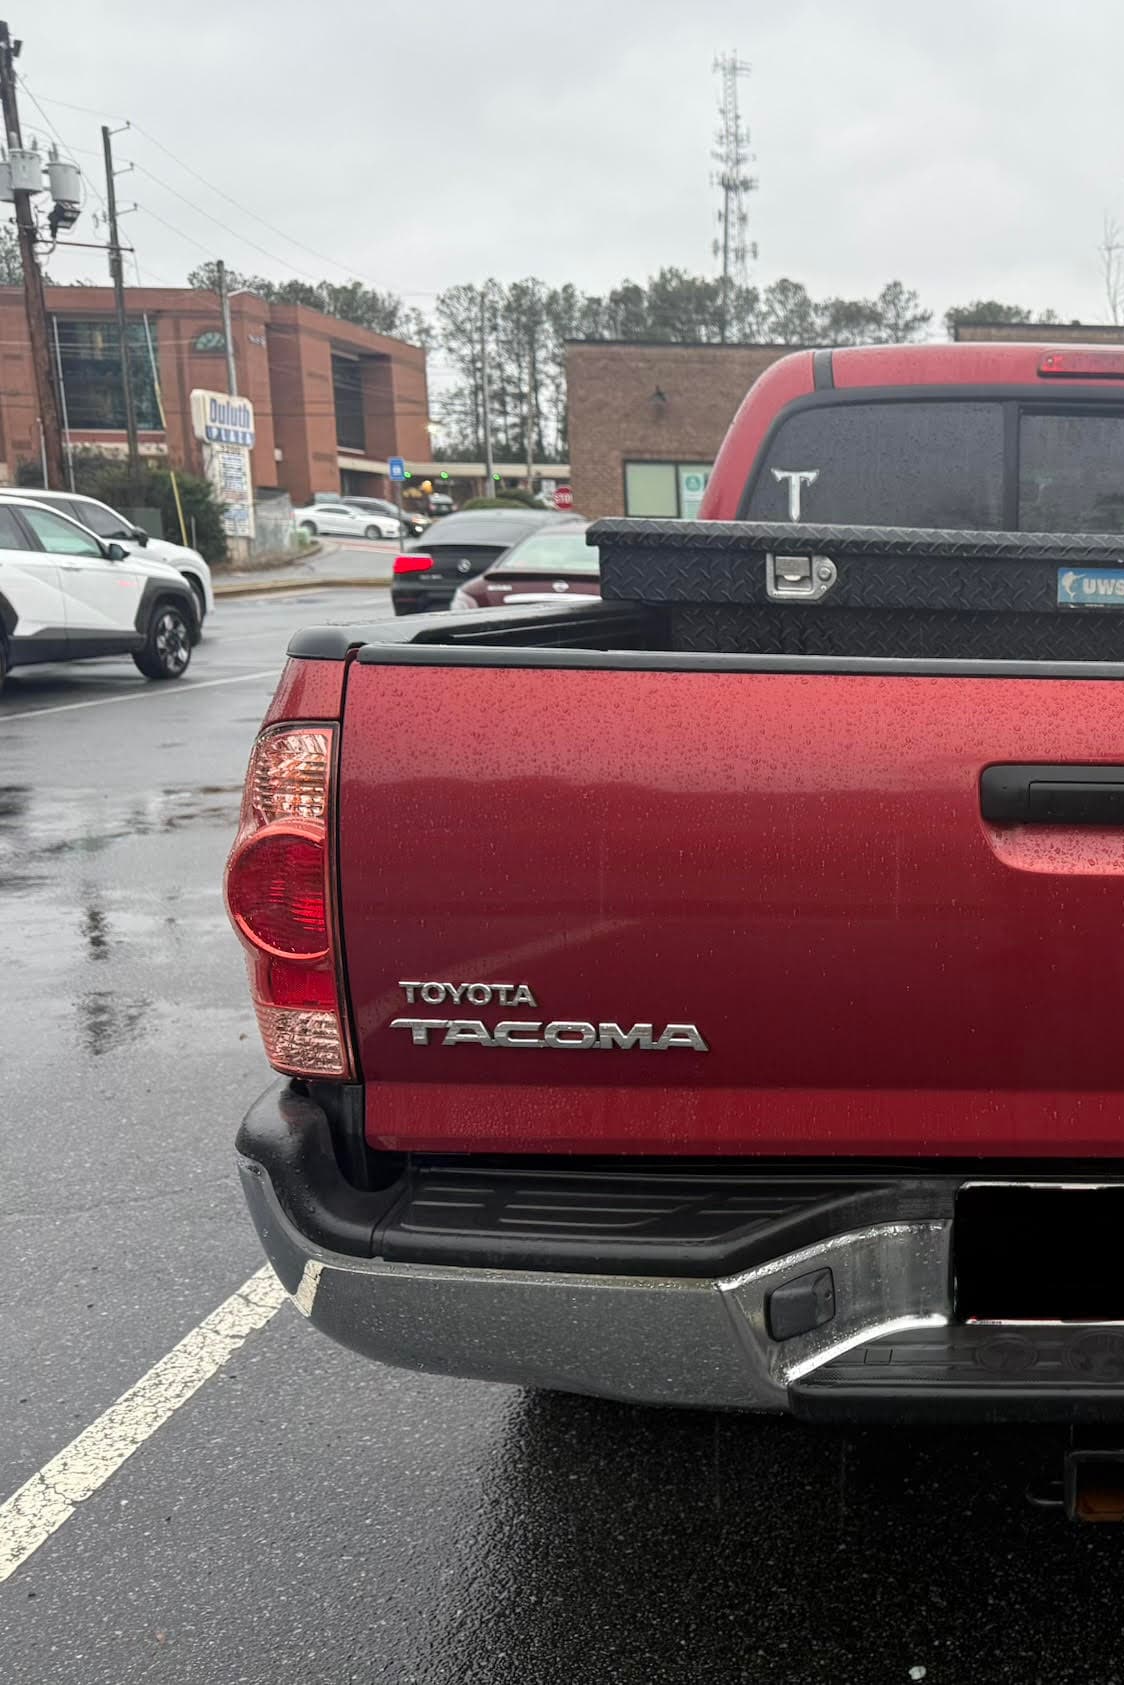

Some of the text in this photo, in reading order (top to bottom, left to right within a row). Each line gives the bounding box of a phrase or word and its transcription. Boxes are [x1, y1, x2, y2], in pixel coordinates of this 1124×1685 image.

[210, 398, 250, 429] Duluth
[398, 981, 538, 1007] TOYOTA
[389, 1018, 709, 1051] TACOMA
